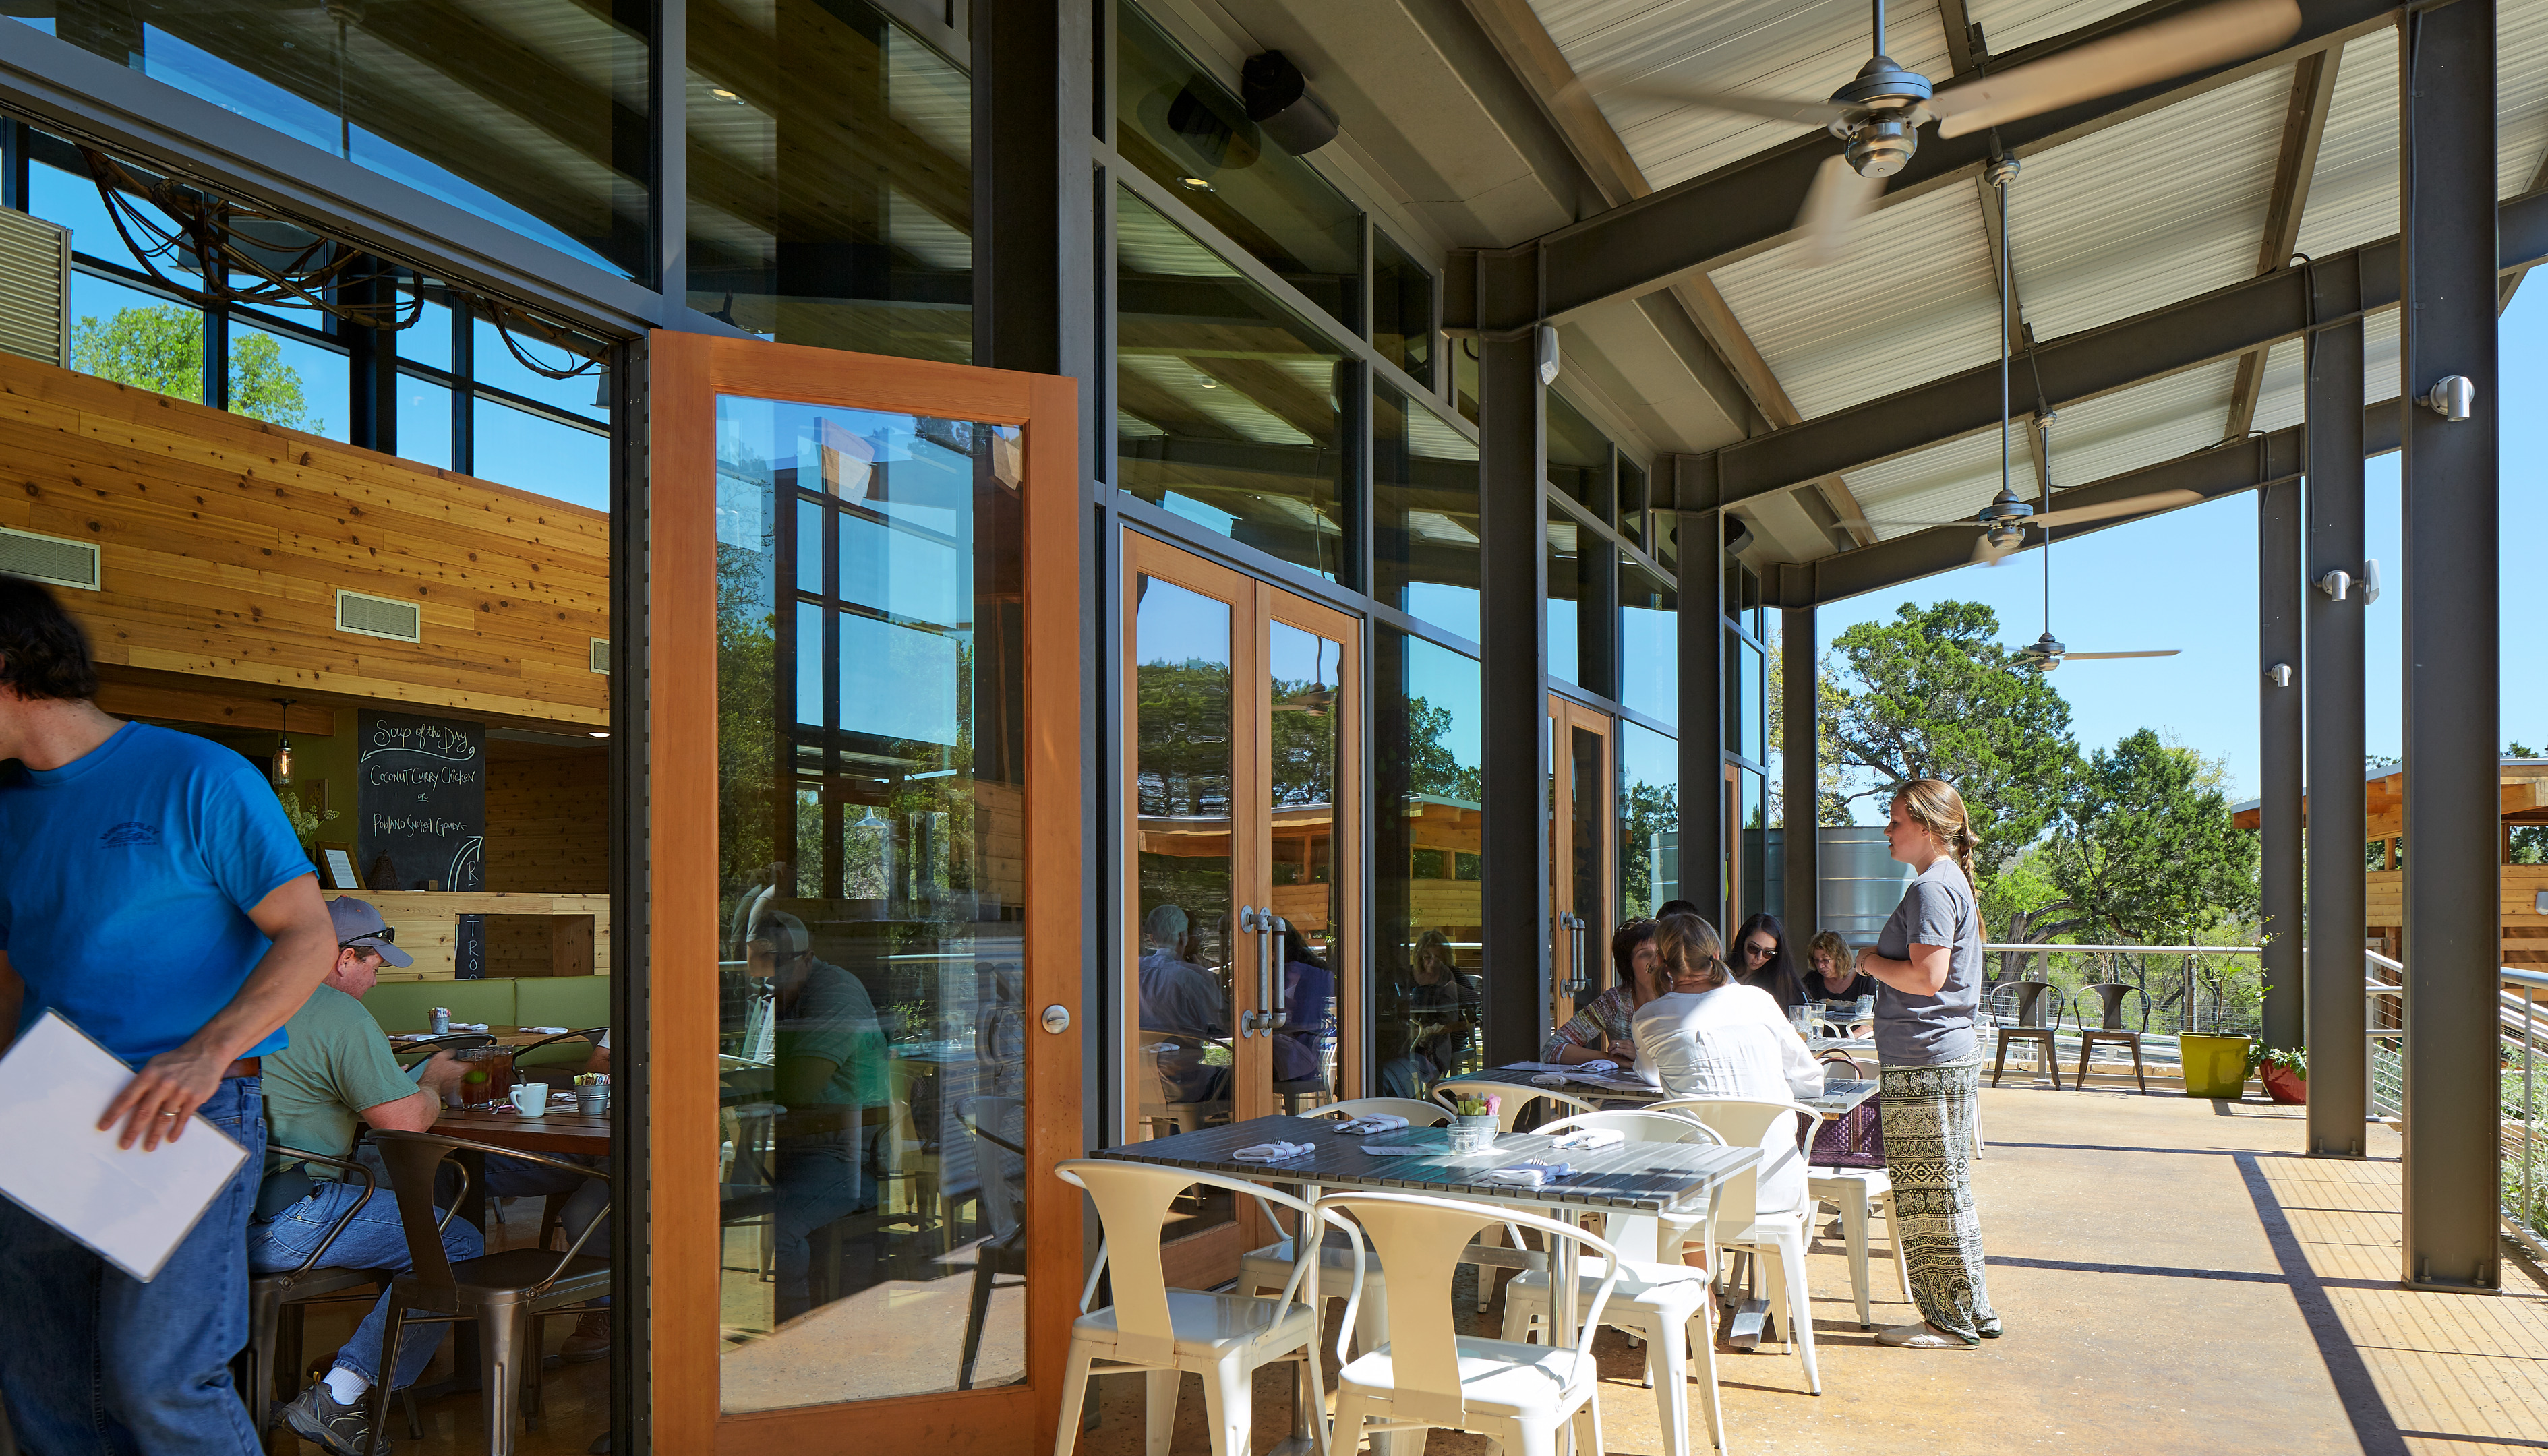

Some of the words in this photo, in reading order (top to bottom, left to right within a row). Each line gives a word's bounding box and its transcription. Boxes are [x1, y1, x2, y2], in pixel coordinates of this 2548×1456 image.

[374, 719, 411, 748] Soup
[415, 723, 426, 749] of
[426, 725, 441, 738] the
